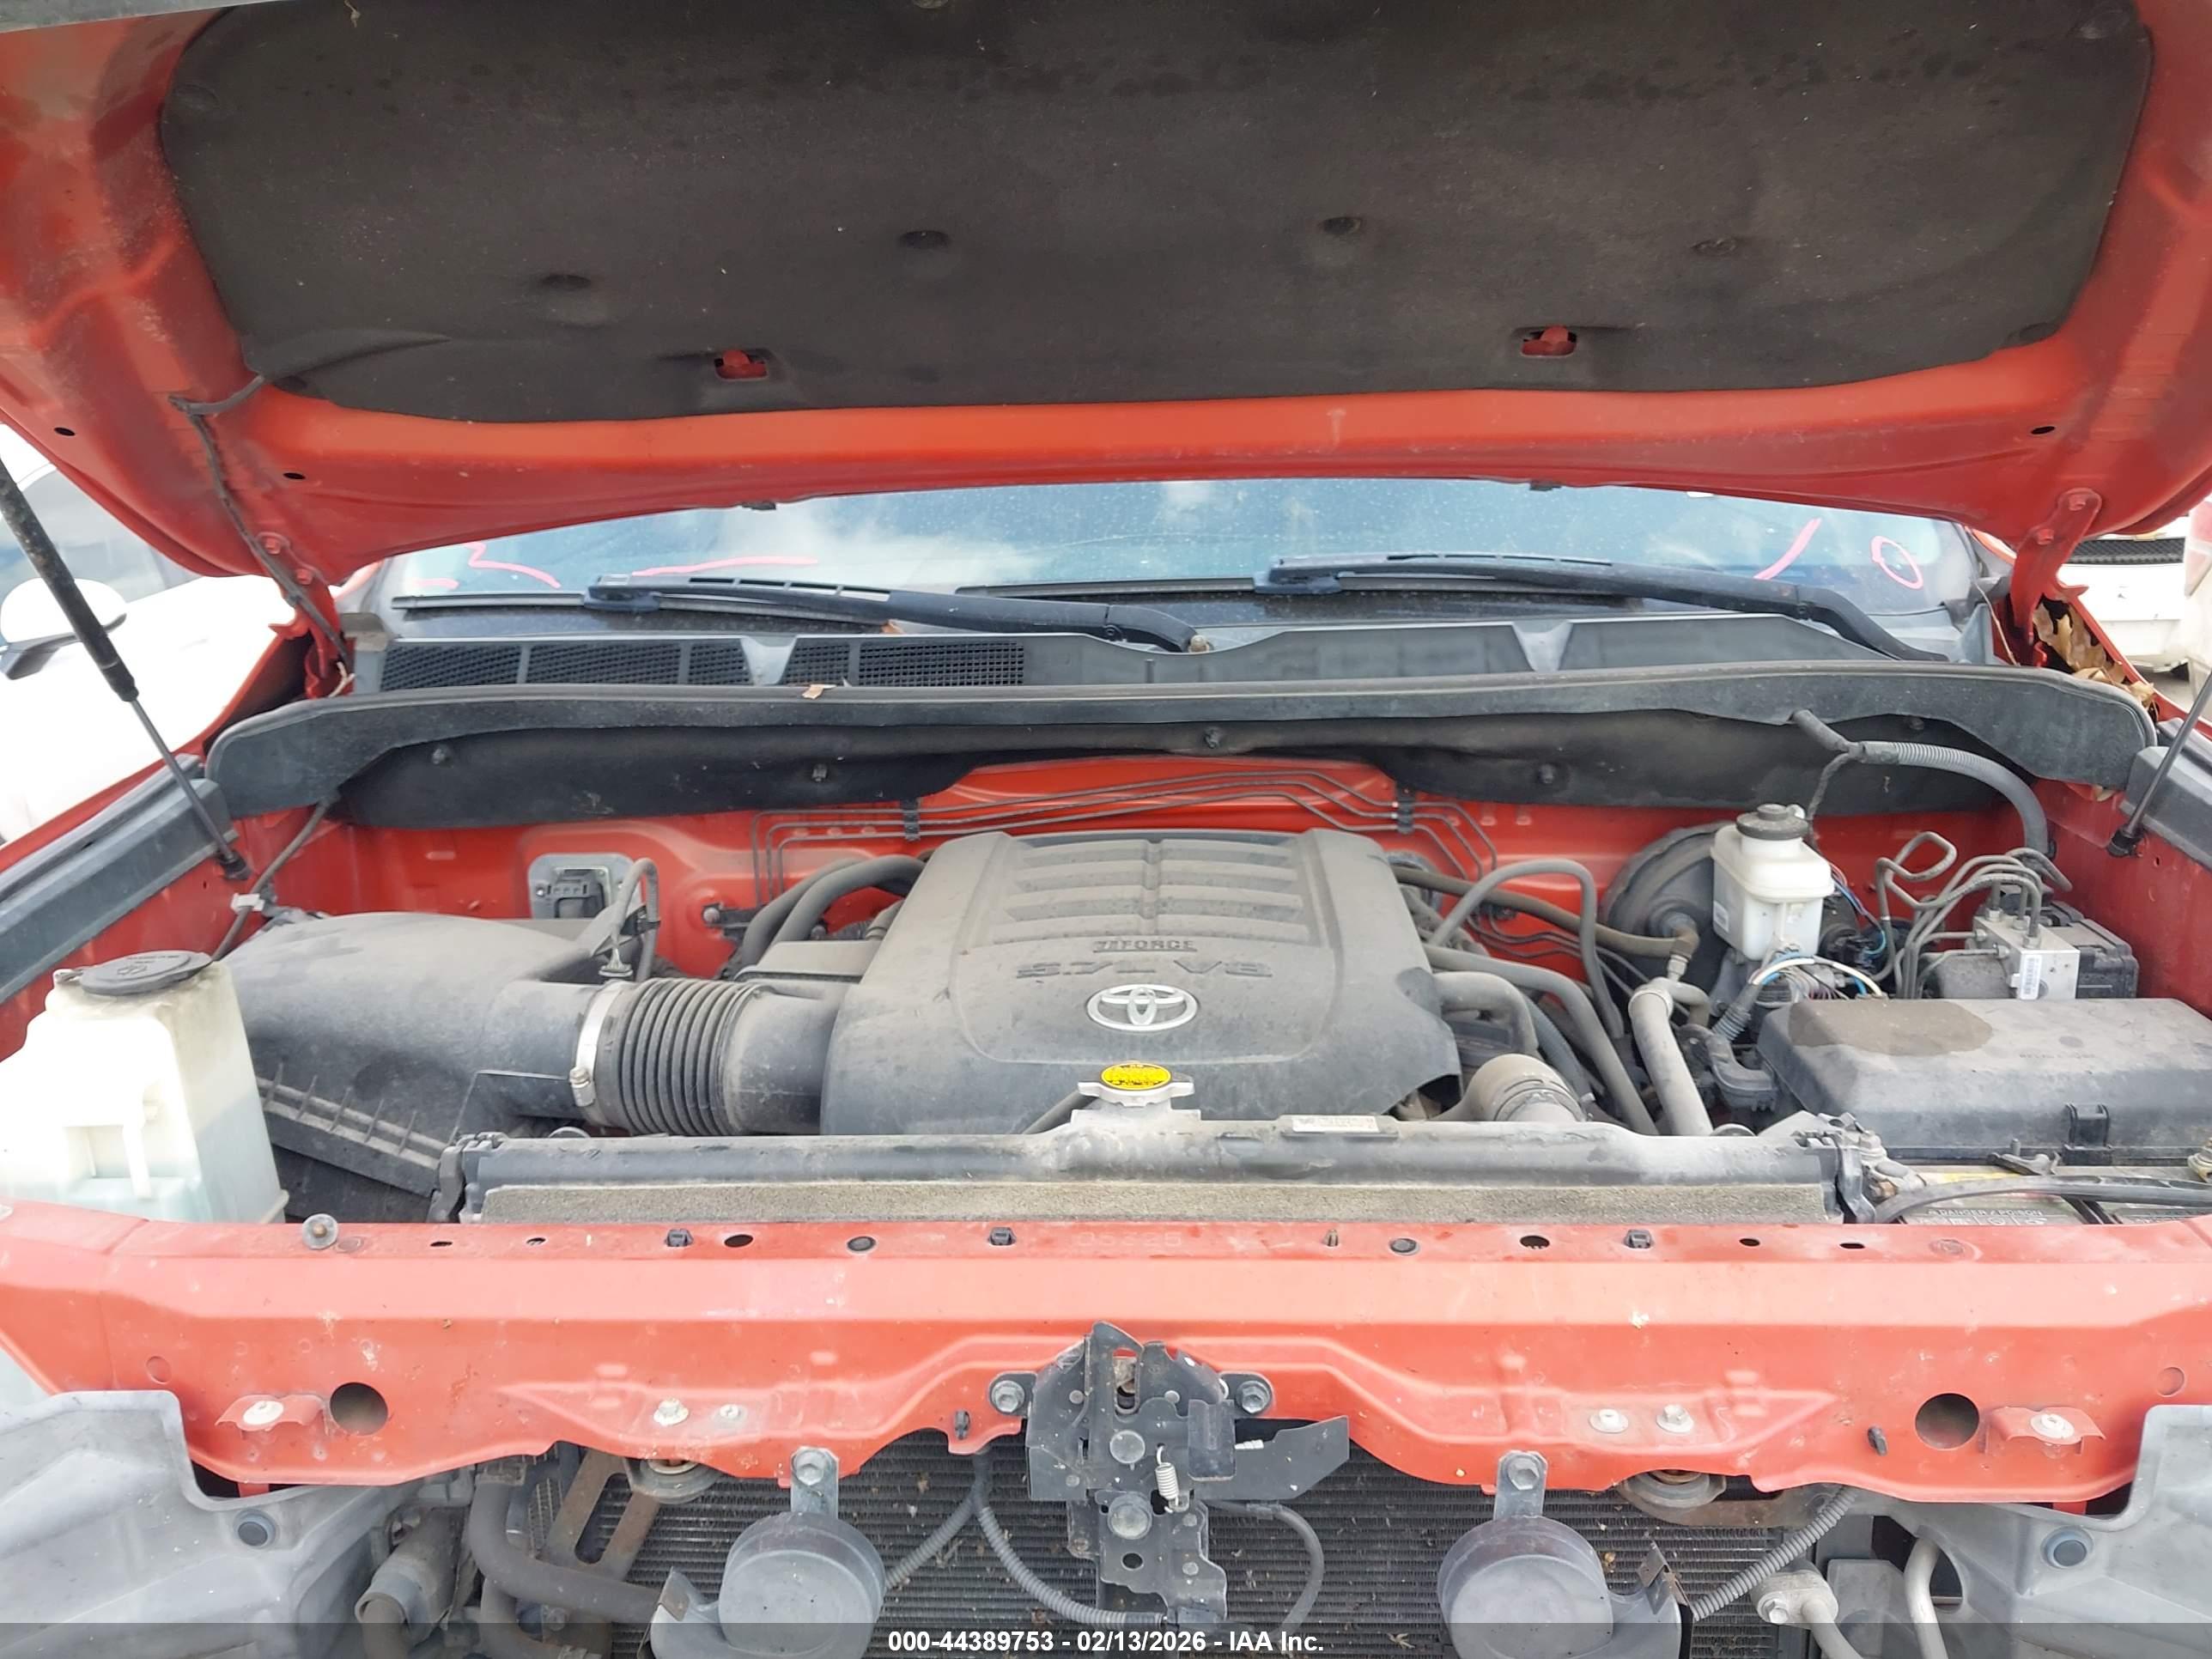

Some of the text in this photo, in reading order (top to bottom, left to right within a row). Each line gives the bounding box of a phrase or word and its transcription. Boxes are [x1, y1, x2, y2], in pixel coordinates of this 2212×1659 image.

[1172, 959, 1273, 978] V8
[1937, 1208, 1987, 1217] DANGER
[1997, 1208, 2043, 1217] POISON
